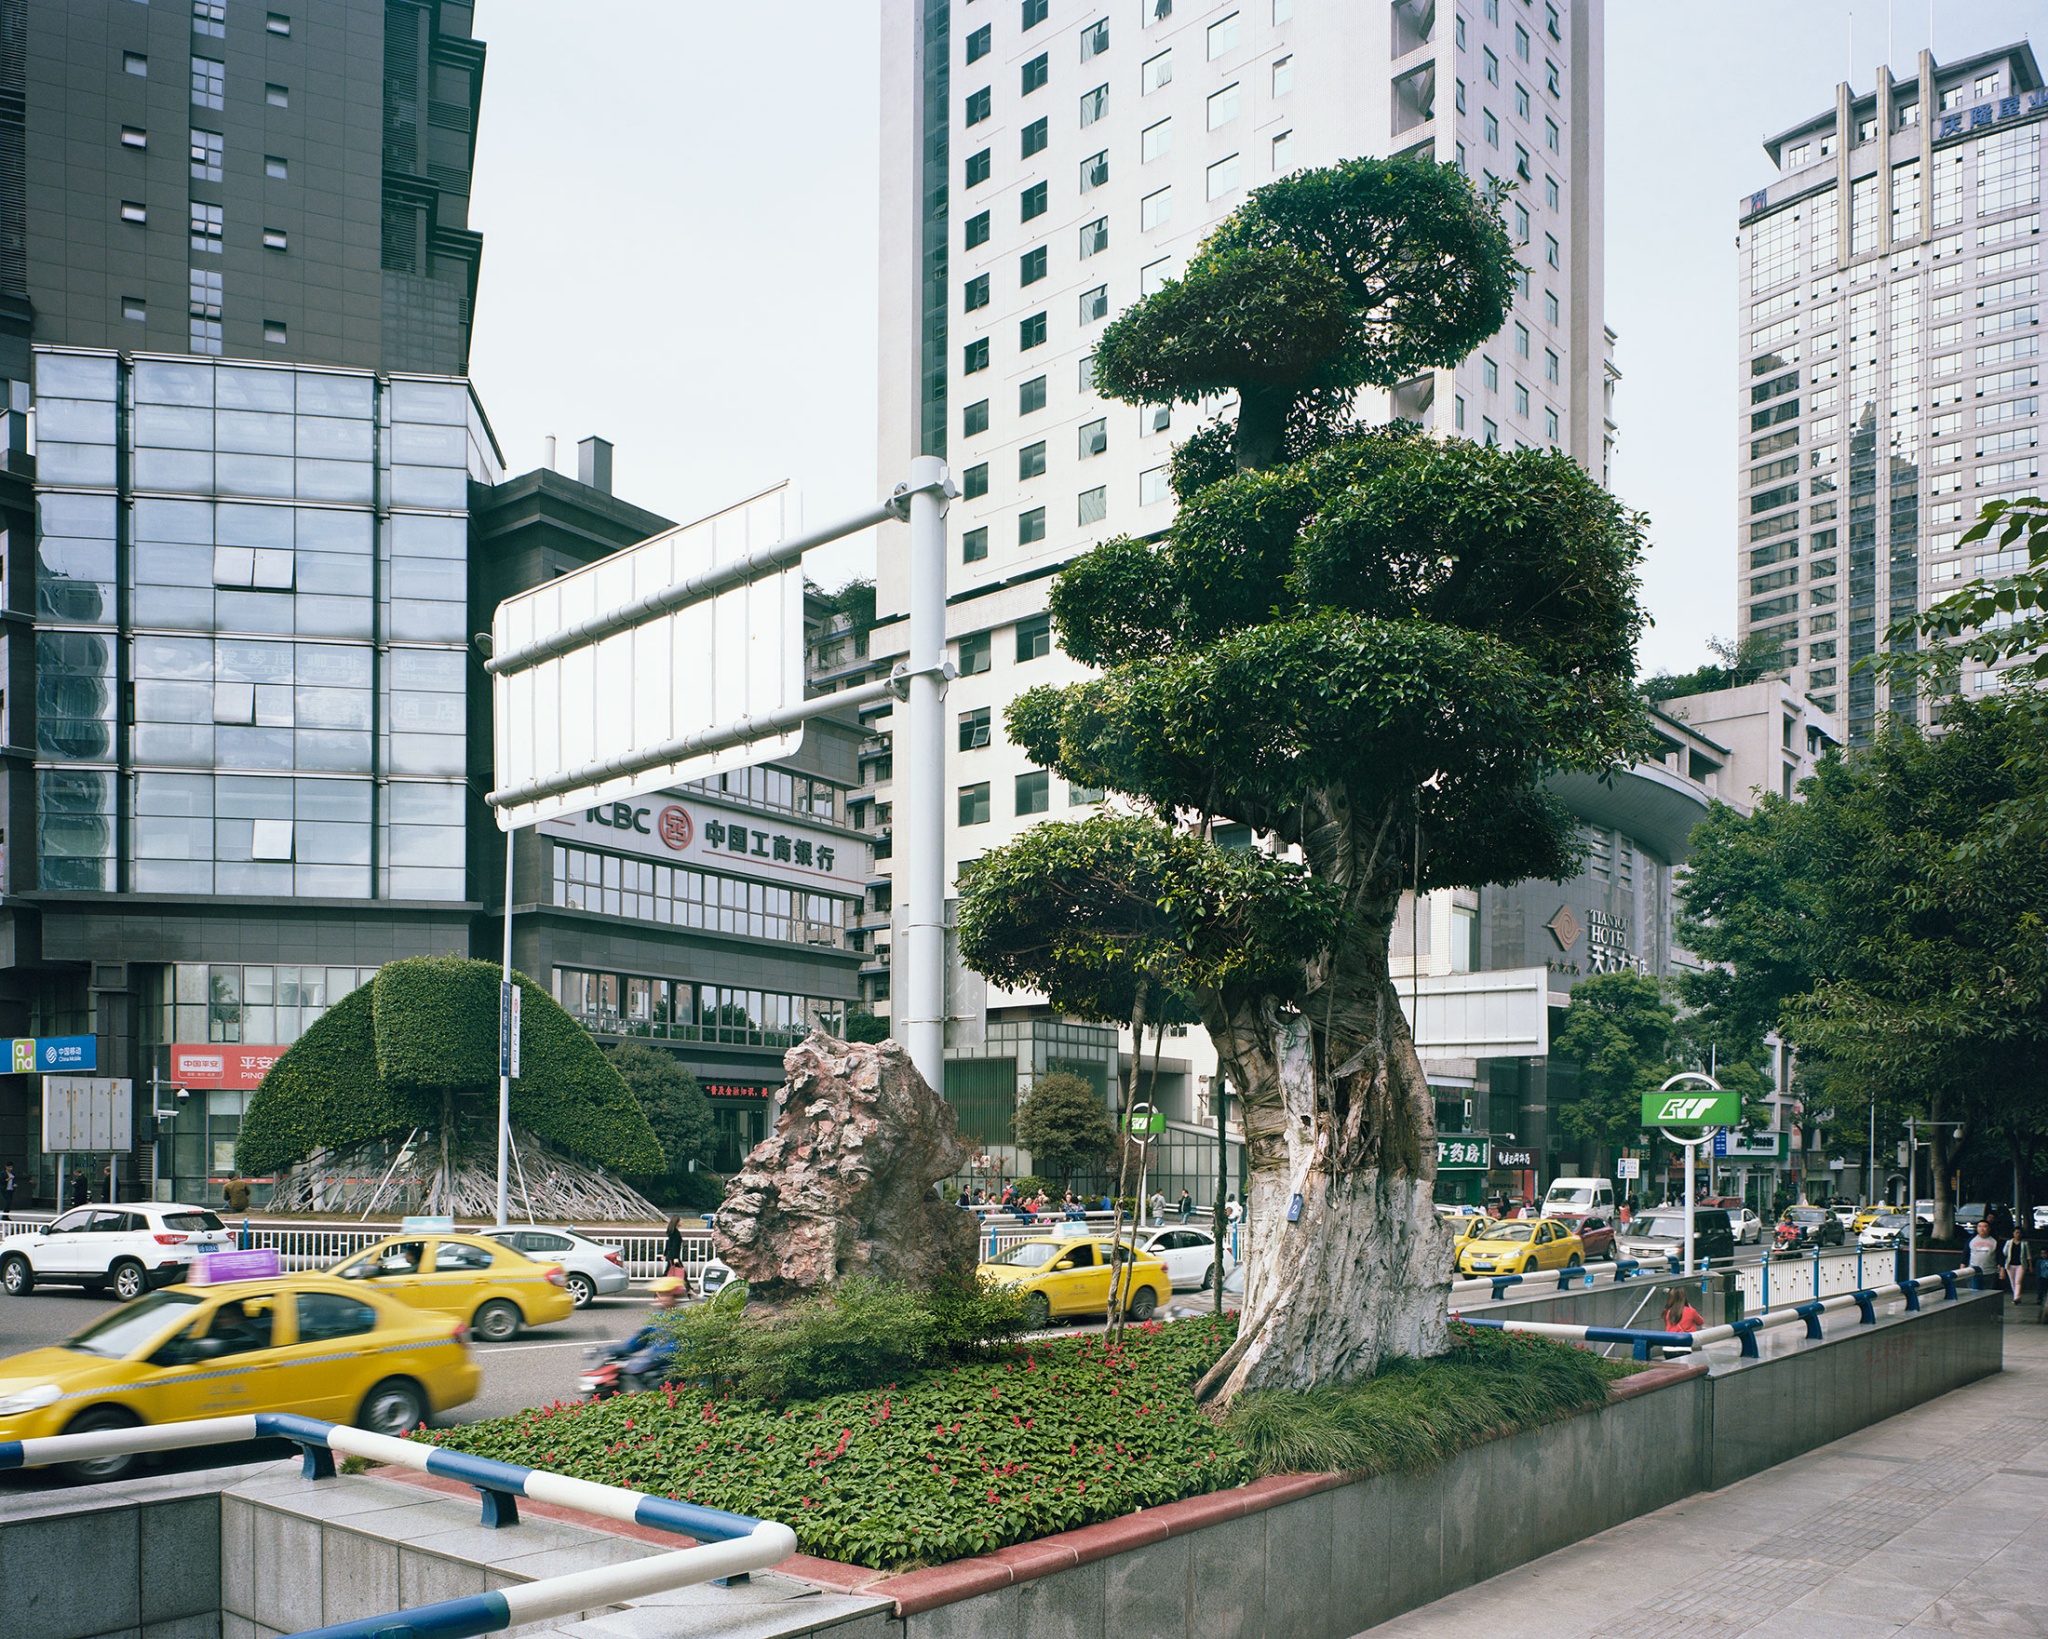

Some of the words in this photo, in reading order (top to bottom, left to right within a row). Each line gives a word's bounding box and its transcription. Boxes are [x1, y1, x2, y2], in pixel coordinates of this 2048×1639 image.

[705, 819, 835, 872] 中国工商银行
[1591, 924, 1630, 950] HOTEL
[183, 1060, 219, 1068] 中国平安
[240, 1056, 280, 1070] 平安
[1291, 1204, 1298, 1214] 2
